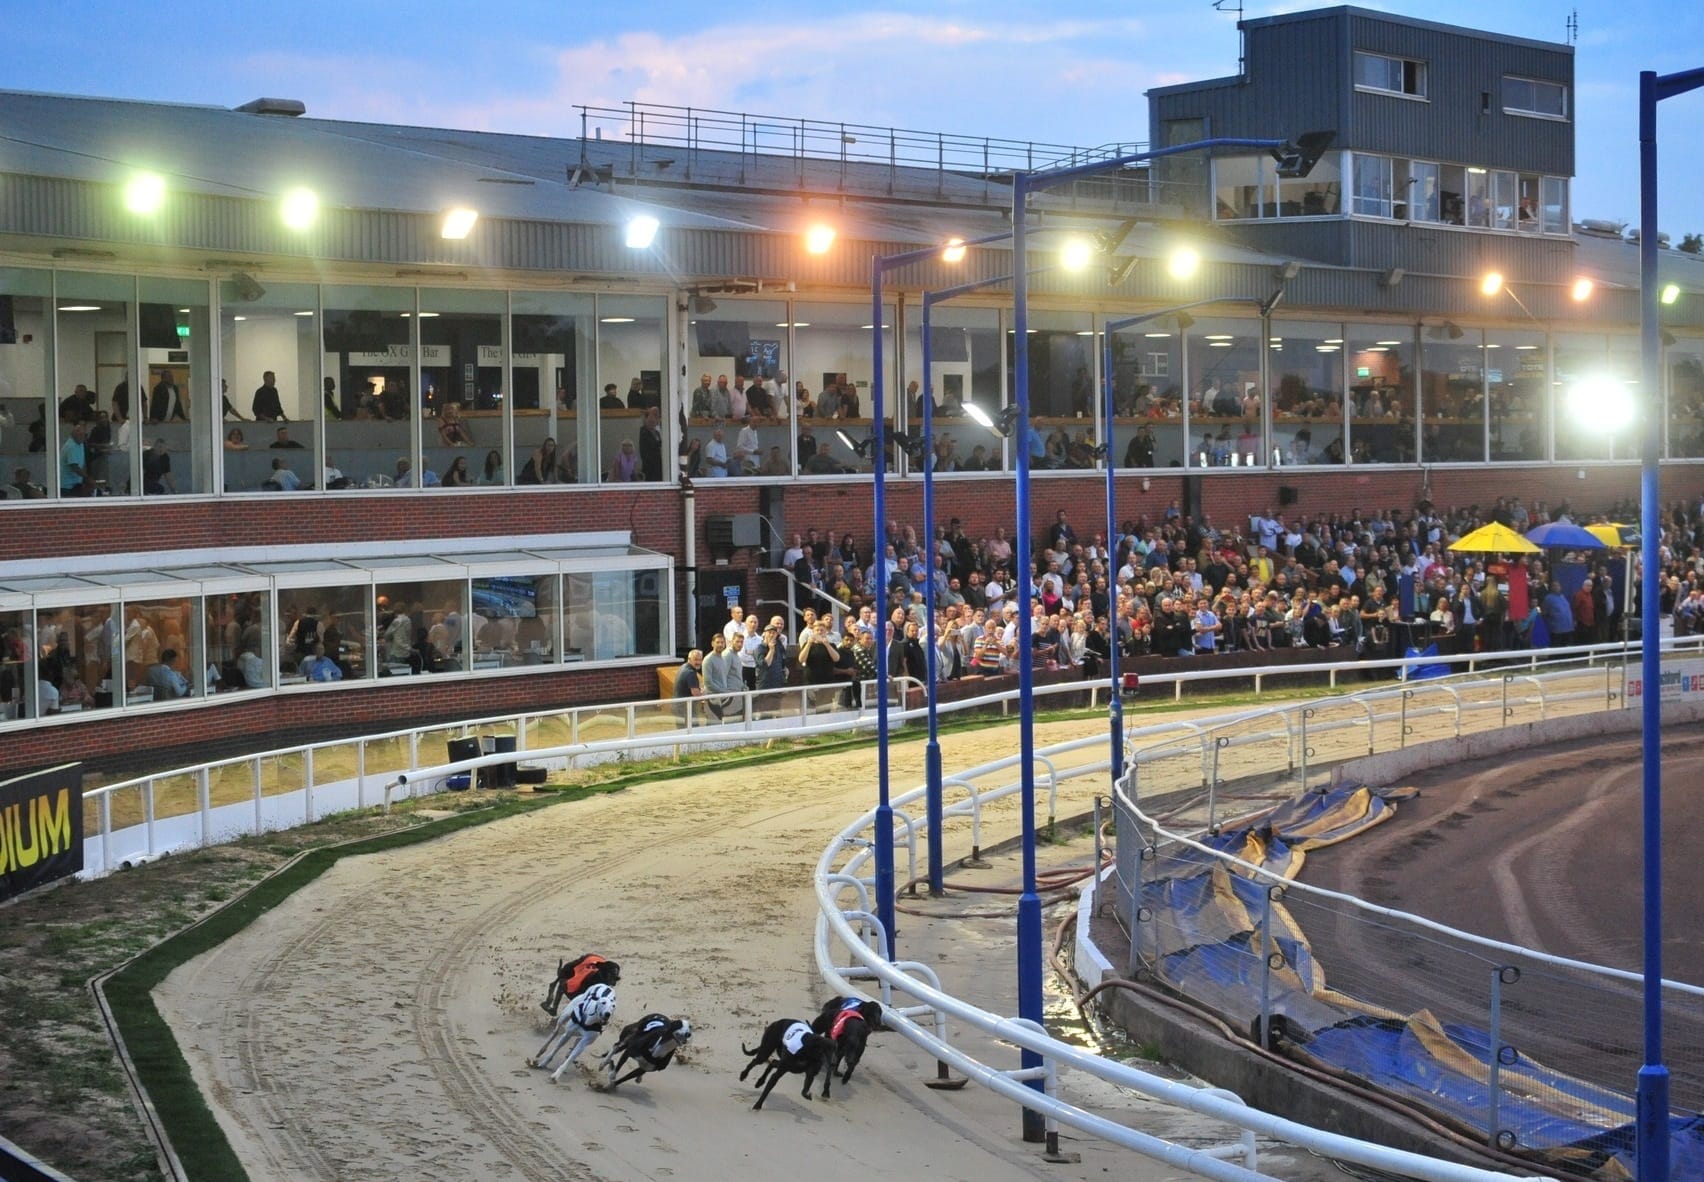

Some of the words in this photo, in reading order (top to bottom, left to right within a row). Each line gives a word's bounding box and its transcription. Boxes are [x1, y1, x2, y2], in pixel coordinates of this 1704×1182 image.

[423, 346, 440, 358] Bar
[481, 347, 498, 359] The
[0, 788, 71, 875] IUM
